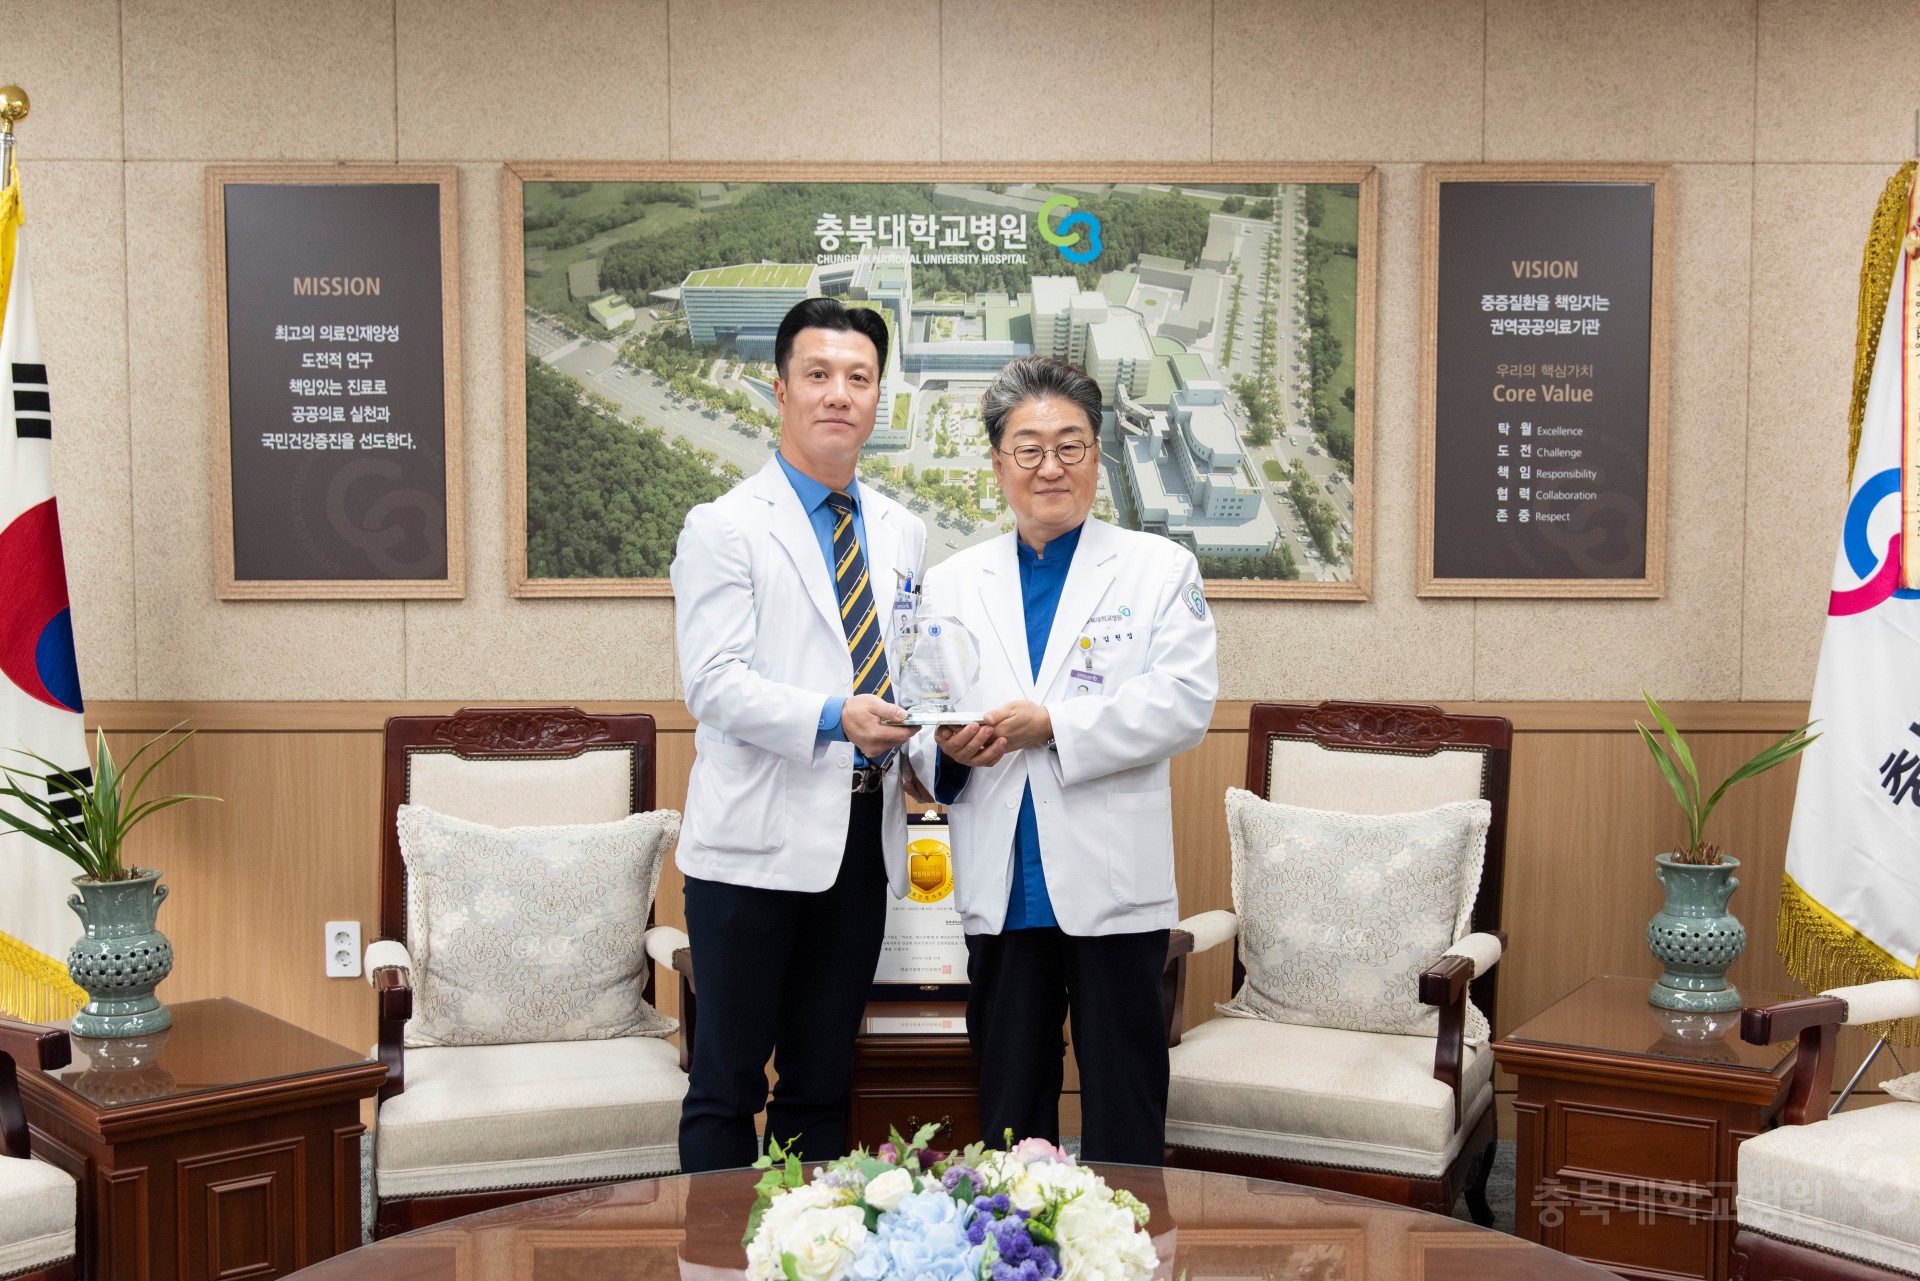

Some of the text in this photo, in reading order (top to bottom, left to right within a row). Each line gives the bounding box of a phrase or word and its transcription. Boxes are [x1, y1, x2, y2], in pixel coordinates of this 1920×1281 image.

[815, 213, 1027, 251] 충북대학교병원
[872, 253, 921, 265] NATIONAL
[923, 253, 979, 265] UNIVERSITY
[981, 253, 1027, 265] HOSPITAL
[1512, 261, 1578, 278] VISION
[294, 277, 380, 296] MISSION
[1481, 294, 1610, 311] 중증질환을 책임지는
[275, 325, 399, 342] 최고의 의료인재양성
[1490, 319, 1600, 335] 권역공공의료기관
[302, 352, 373, 369] 도전적 연구
[1496, 364, 1592, 378] 우리의 핵심가치
[289, 379, 387, 396] 책임있는 진료로
[1493, 384, 1593, 402] Core Value
[292, 406, 390, 423] 공공의료 실천과
[1537, 426, 1583, 436] Excellence
[261, 433, 416, 450] 국민건강증진을 선도한다.
[1537, 448, 1582, 459] Challenge
[1537, 469, 1597, 480] Responsibility
[1536, 491, 1597, 500] Collaboration
[1536, 512, 1570, 523] Respect
